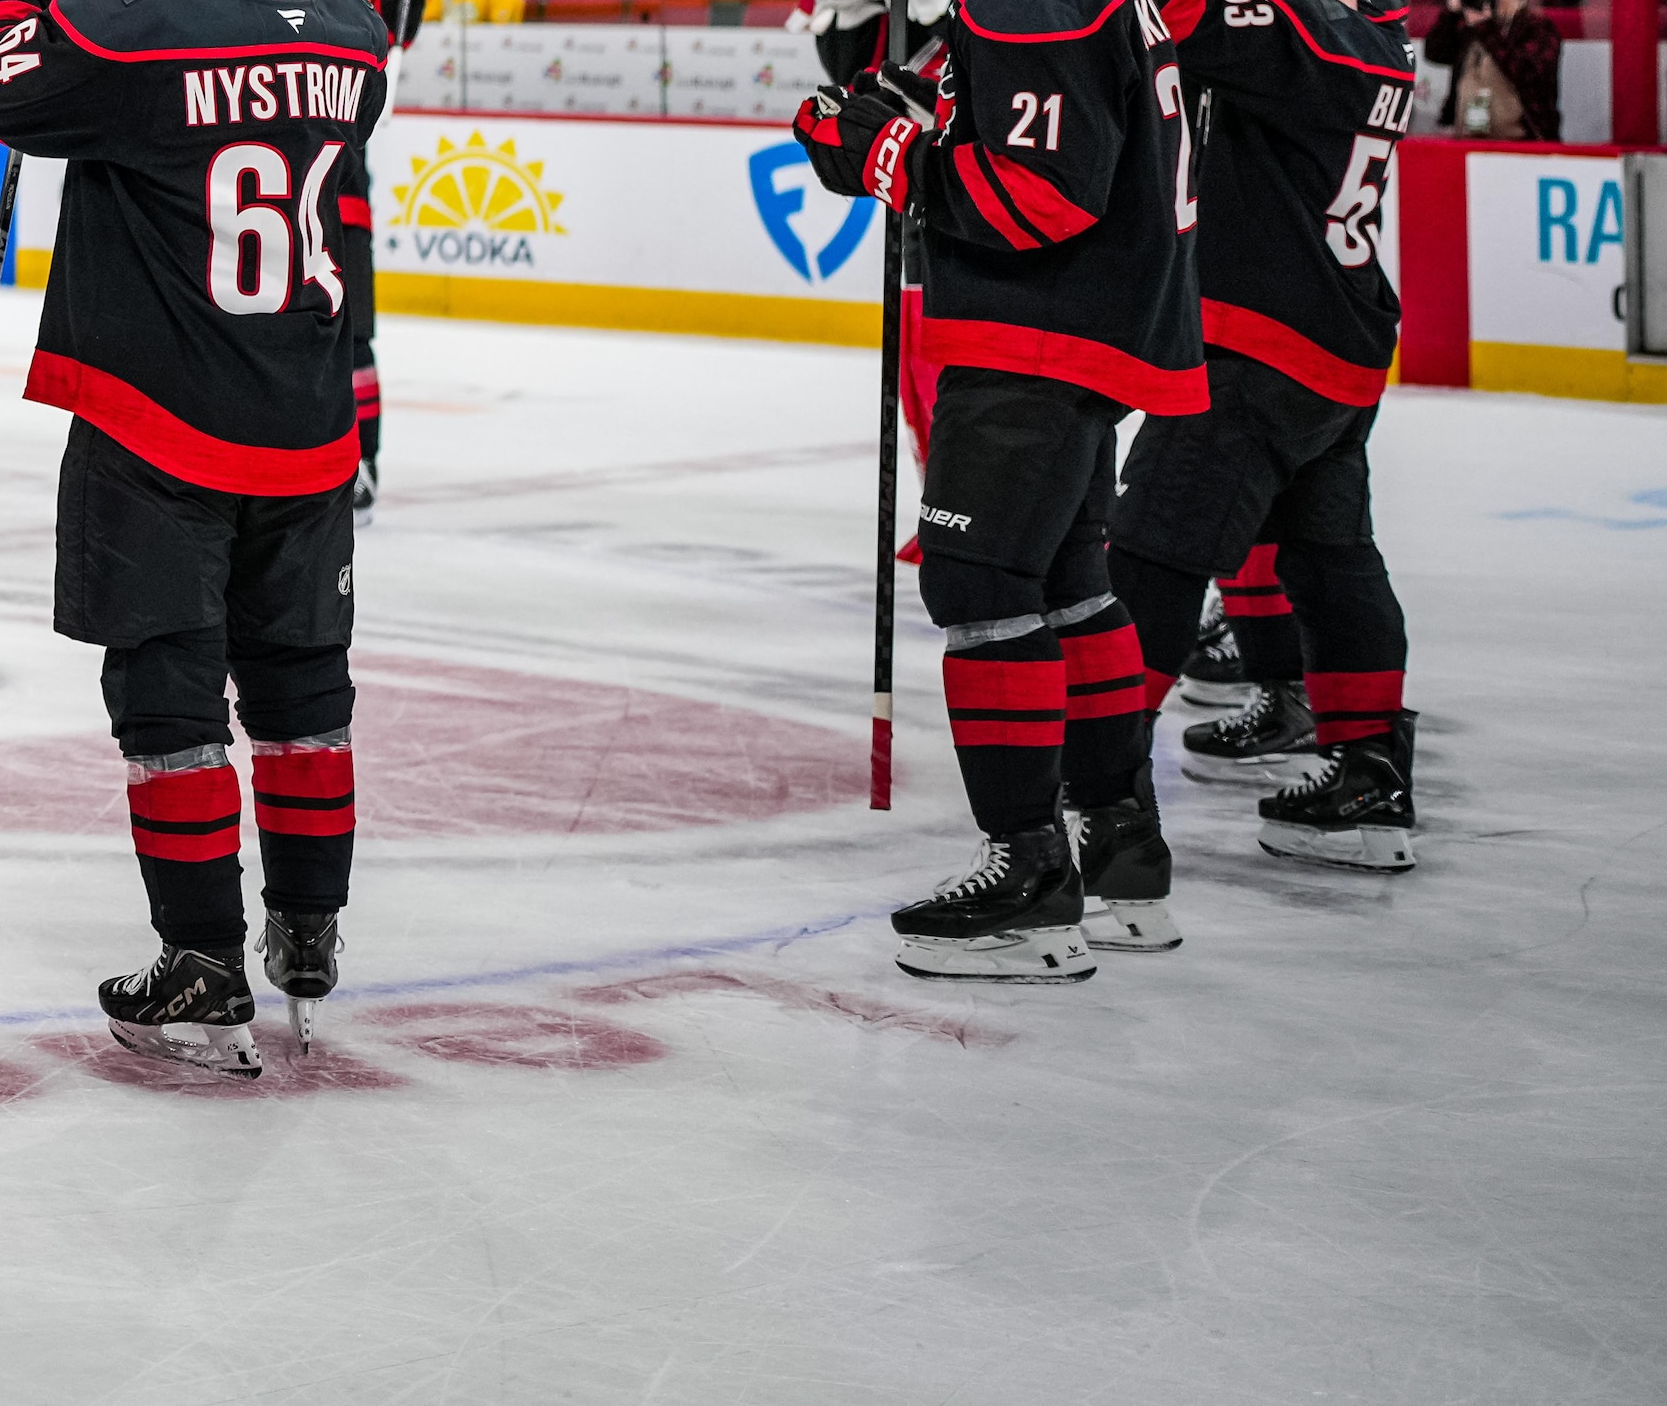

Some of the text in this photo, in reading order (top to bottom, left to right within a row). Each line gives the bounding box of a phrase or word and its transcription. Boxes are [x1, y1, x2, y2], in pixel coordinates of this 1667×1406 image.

[183, 62, 366, 126] NYSTROM
[1006, 90, 1063, 151] 21
[873, 116, 914, 205] CCM
[206, 140, 345, 316] 64
[413, 230, 535, 267] VODKA
